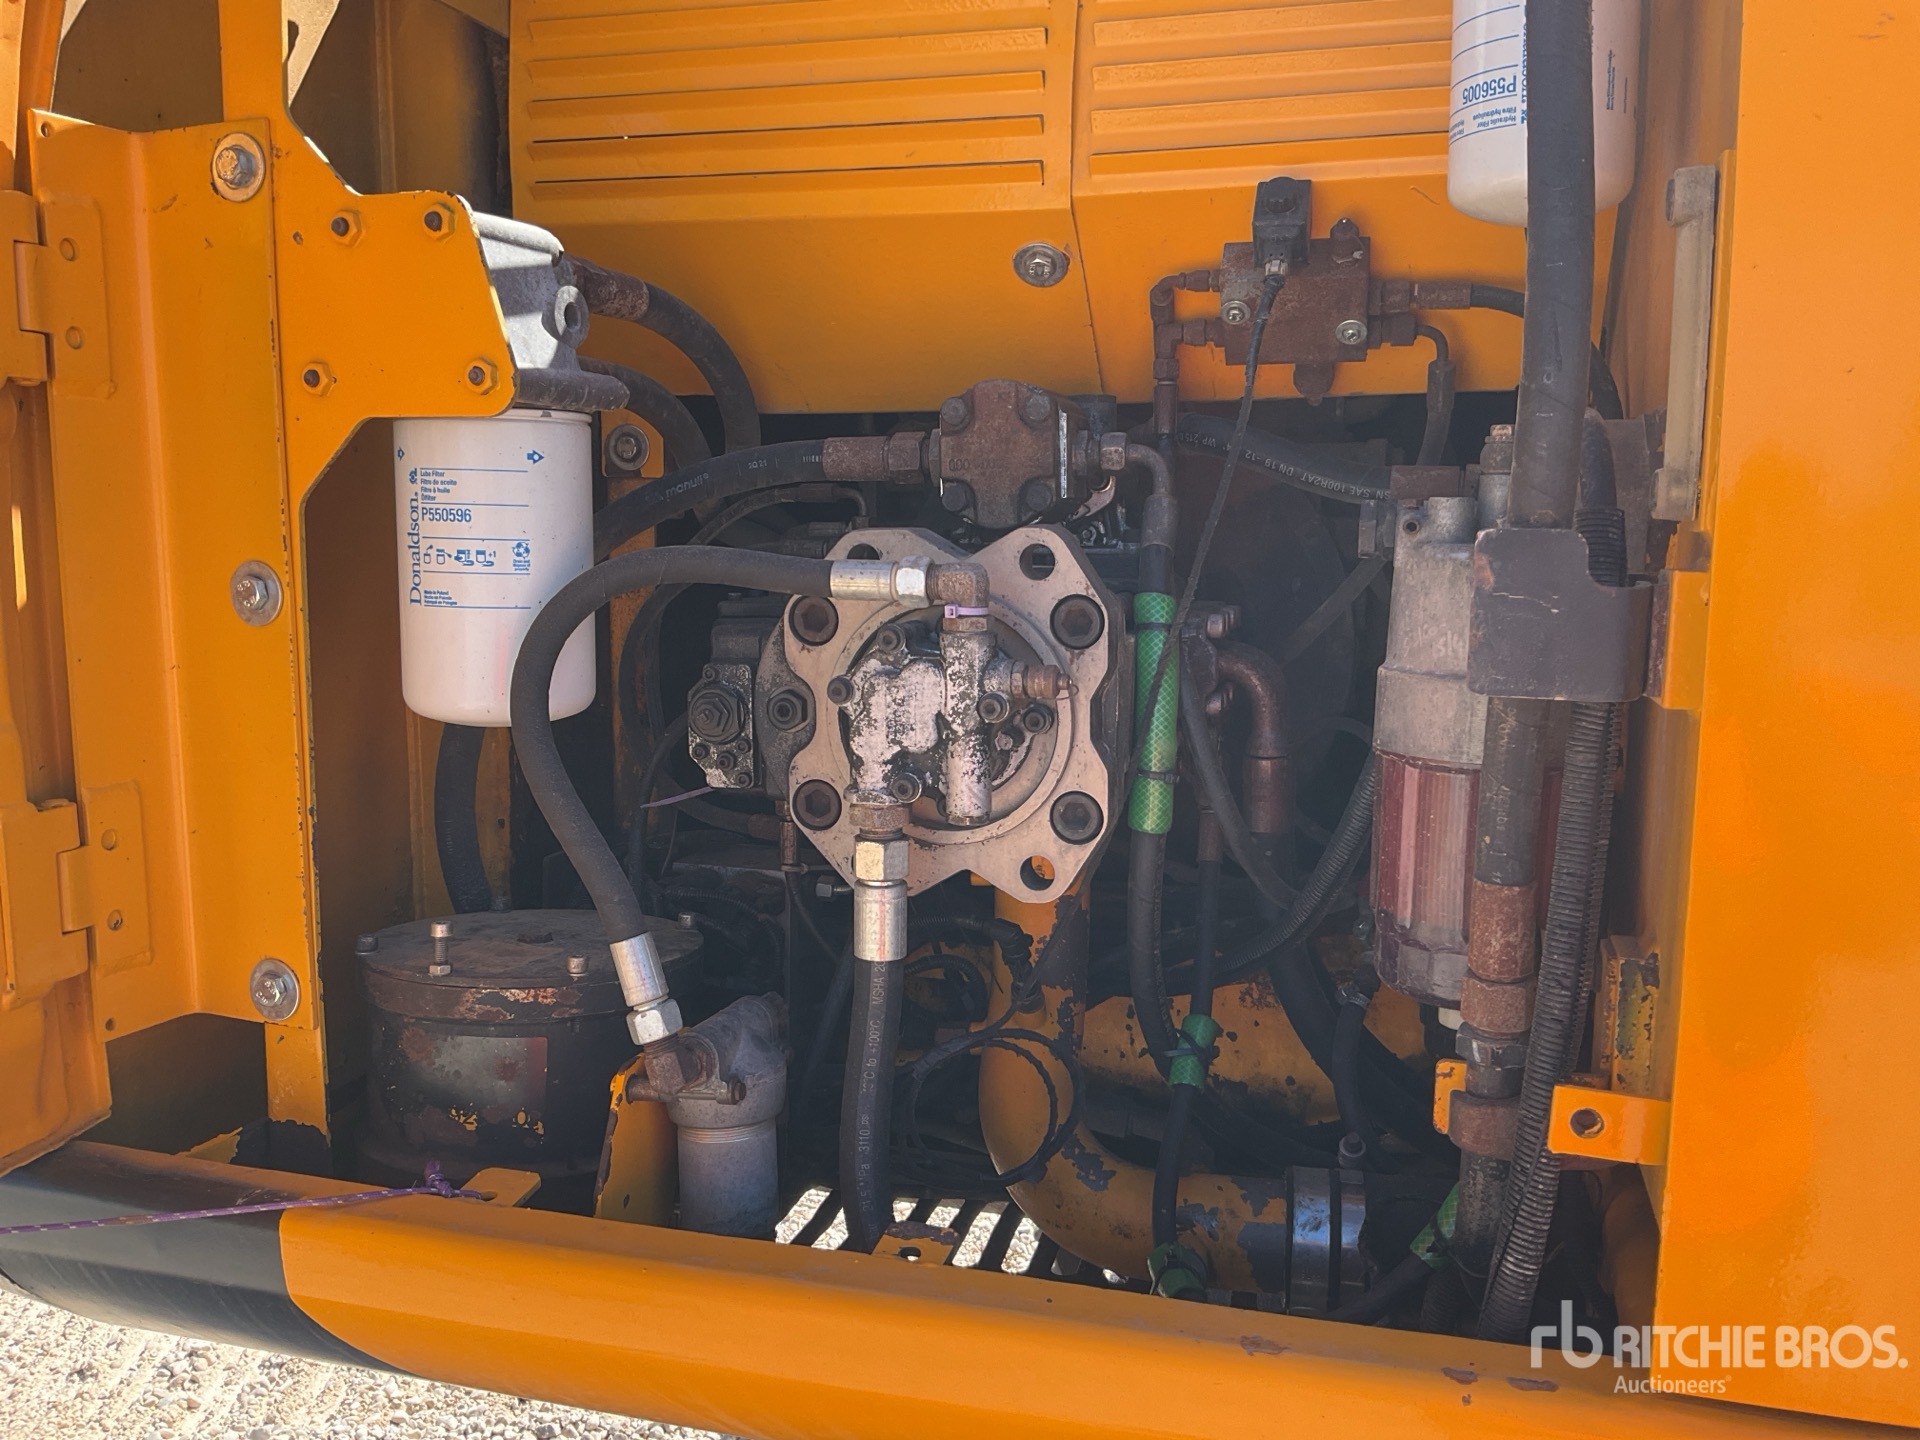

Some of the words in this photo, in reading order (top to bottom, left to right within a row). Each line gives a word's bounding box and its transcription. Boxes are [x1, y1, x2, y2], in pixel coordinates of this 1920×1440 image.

[1462, 75, 1517, 105] P556005
[1490, 115, 1517, 125] Hydraulic
[1278, 465, 1294, 477] DN
[1300, 472, 1345, 493] 100R2AT
[1349, 485, 1371, 498] SAE
[421, 508, 472, 523] P550596
[858, 1129, 871, 1152] 3110
[872, 976, 885, 1005] MSHA
